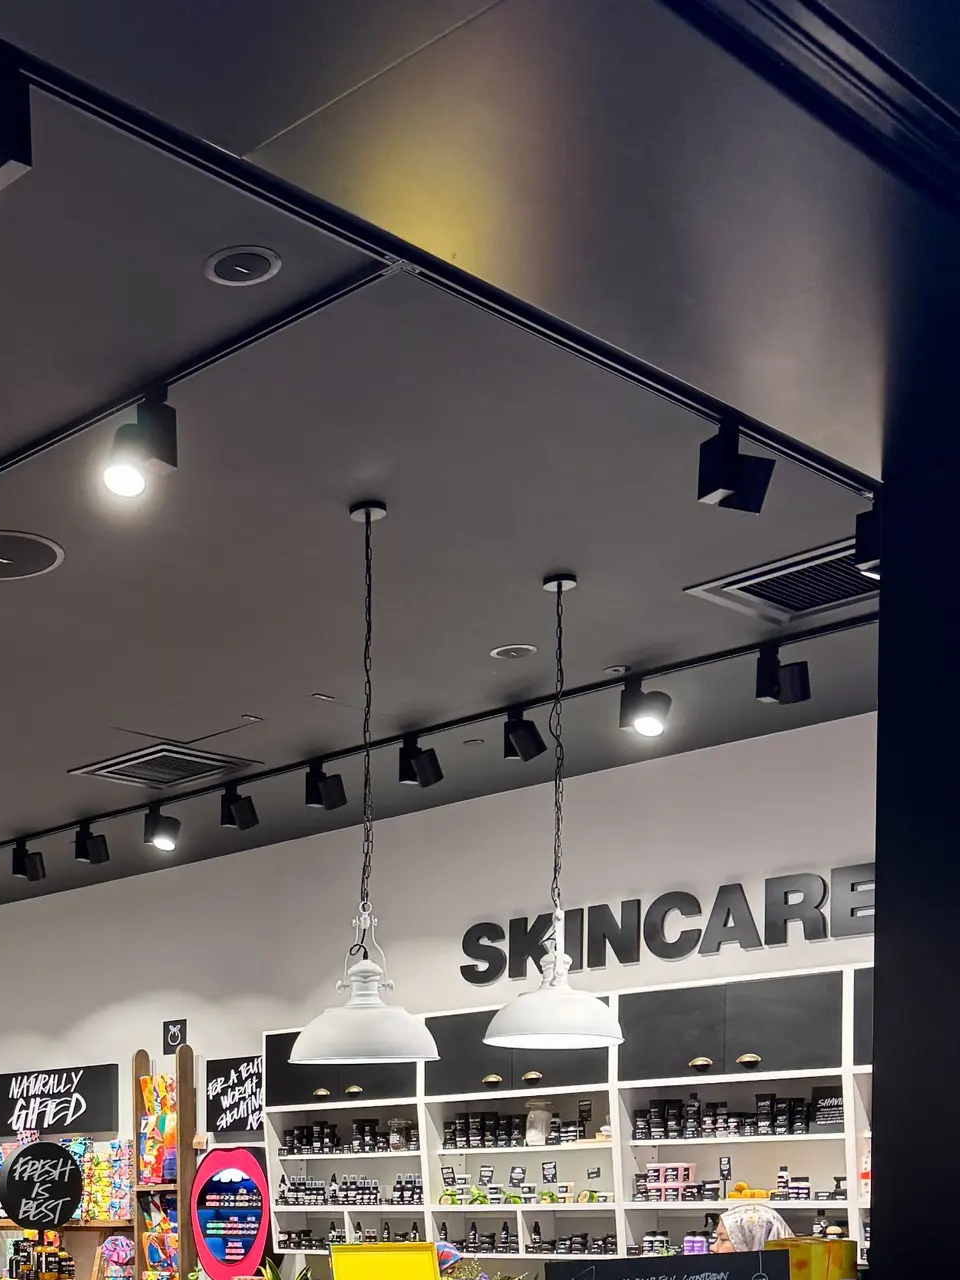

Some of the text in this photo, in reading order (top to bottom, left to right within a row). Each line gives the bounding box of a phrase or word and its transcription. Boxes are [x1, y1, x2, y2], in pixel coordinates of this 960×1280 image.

[459, 862, 876, 985] SKINCARE
[8, 1070, 84, 1099] NATURALLY
[208, 1077, 229, 1100] FOR
[228, 1068, 239, 1086] A
[221, 1075, 259, 1109] WORTH
[8, 1093, 87, 1132] GIFTED
[817, 1097, 843, 1108] SHAVI
[12, 1156, 76, 1183] FRESH
[31, 1182, 53, 1199] IS
[19, 1197, 71, 1225] BEST
